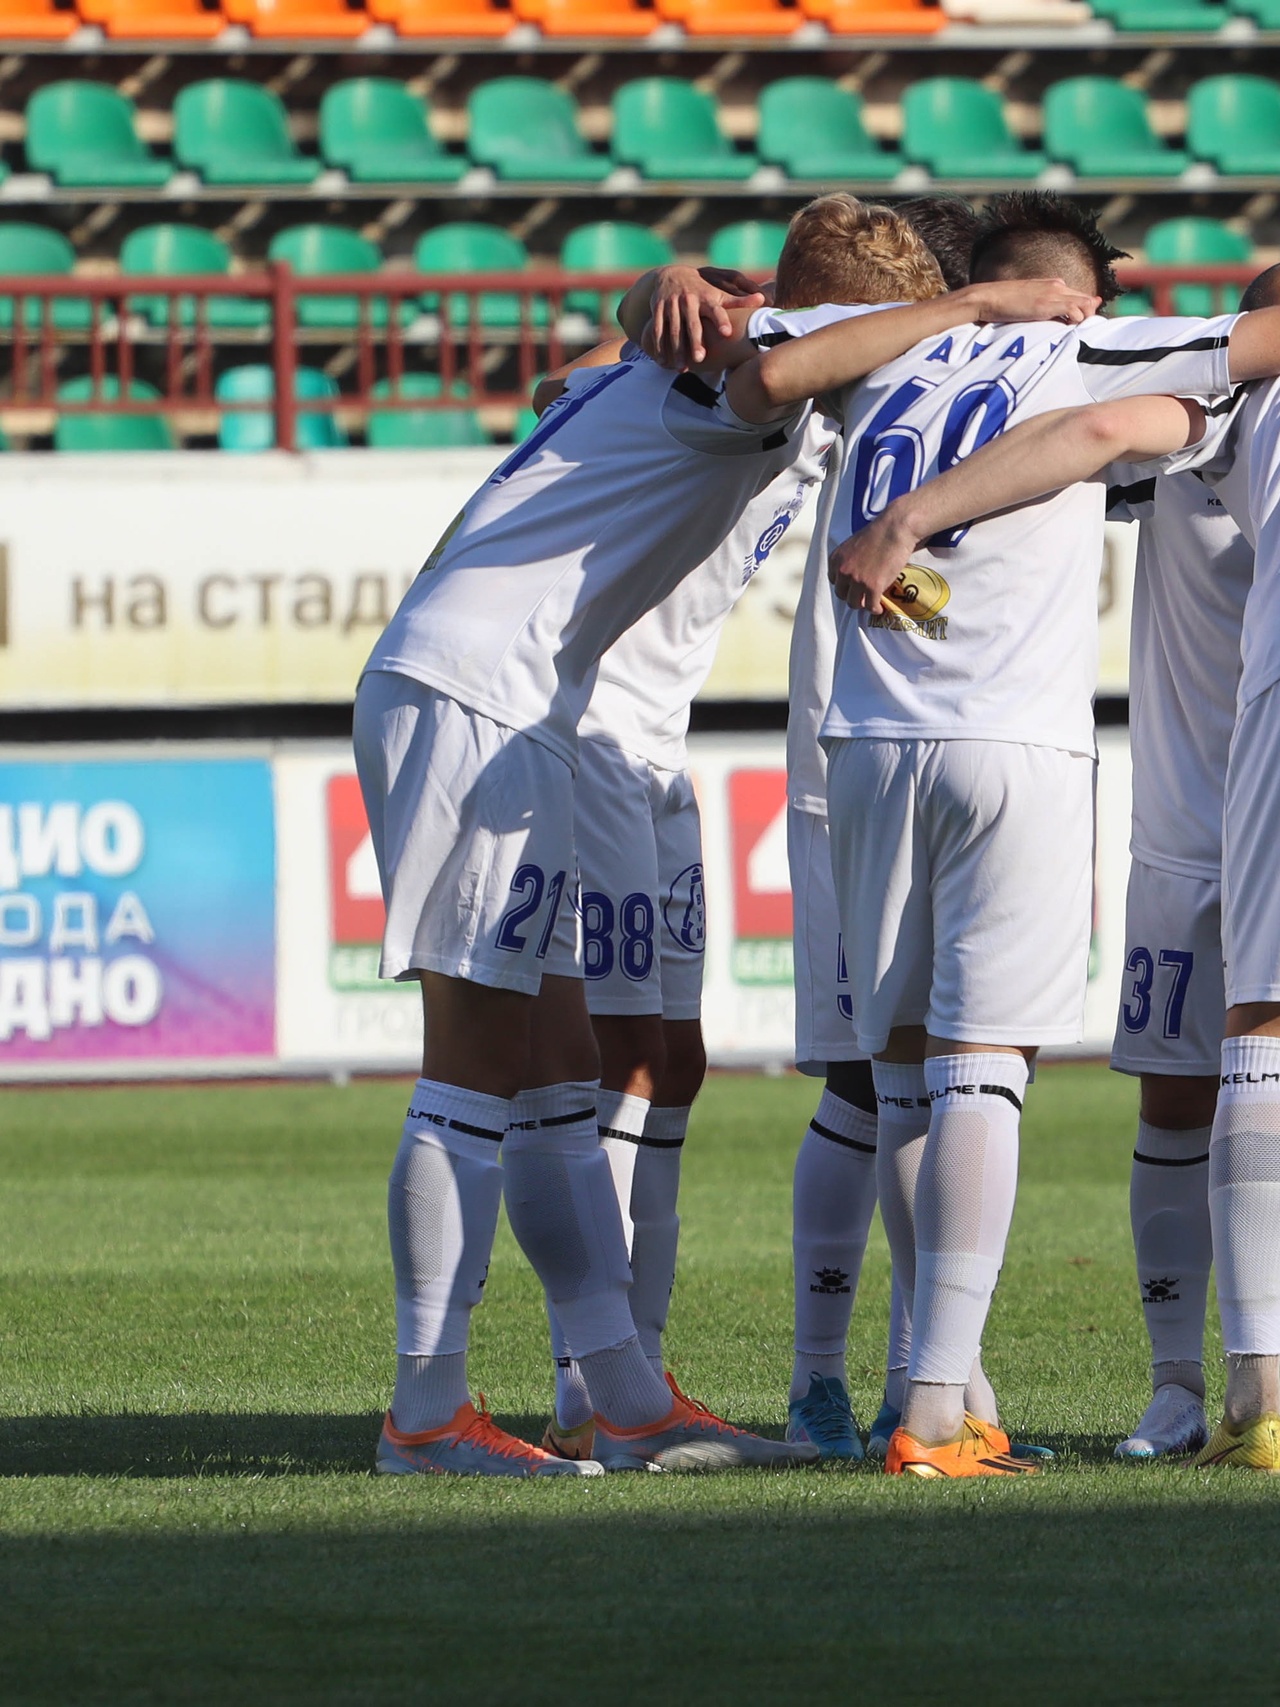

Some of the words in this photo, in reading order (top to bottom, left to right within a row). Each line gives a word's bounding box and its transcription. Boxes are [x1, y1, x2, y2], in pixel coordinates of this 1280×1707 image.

[70, 571, 168, 630] на
[197, 571, 413, 636] стад
[495, 864, 567, 960] 21
[582, 892, 655, 982] 88
[1122, 946, 1195, 1041] 37
[810, 1284, 850, 1295] KELME
[1142, 1294, 1180, 1304] KELME
